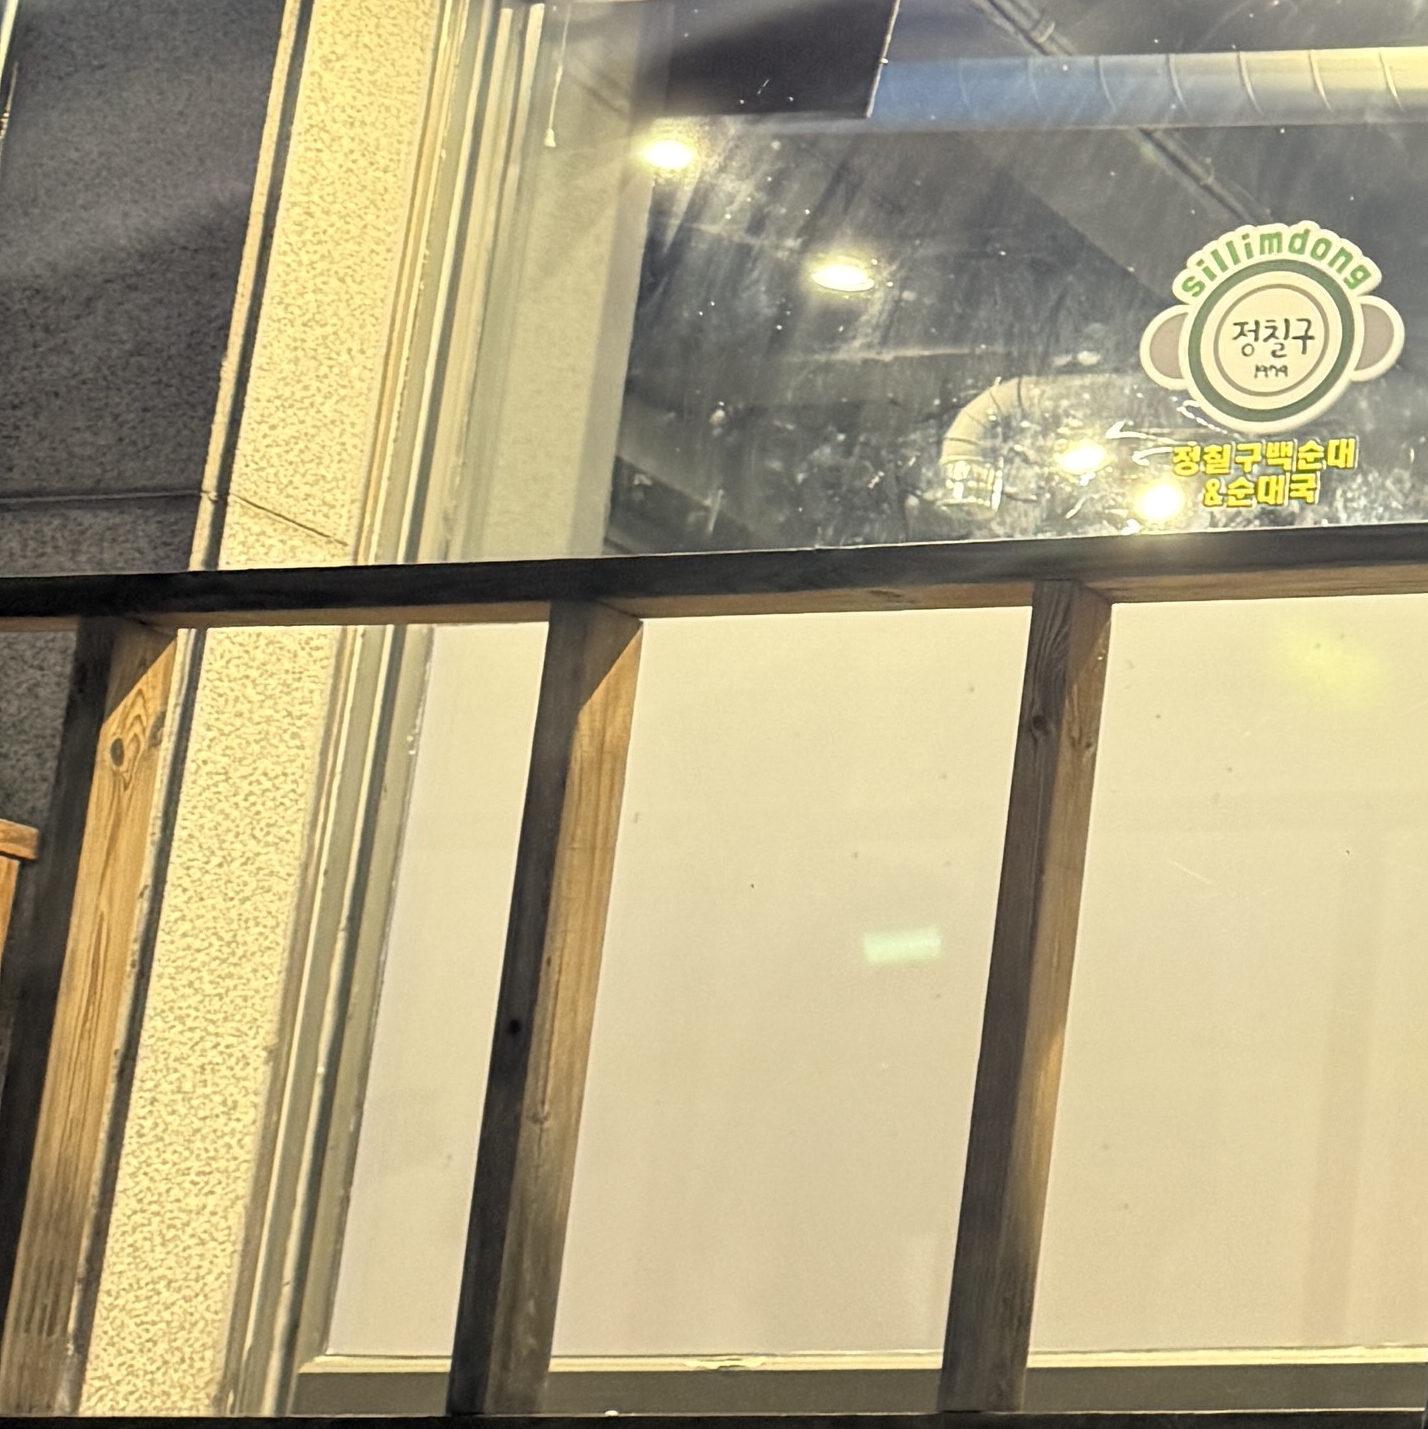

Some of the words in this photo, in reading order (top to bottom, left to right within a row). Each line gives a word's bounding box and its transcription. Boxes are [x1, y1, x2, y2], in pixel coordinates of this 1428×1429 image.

[1181, 227, 1372, 298] sillimdong
[1232, 317, 1316, 359] 정칠구
[1171, 437, 1356, 477] 정칠구백순대
[1202, 473, 1318, 508] &순대국
